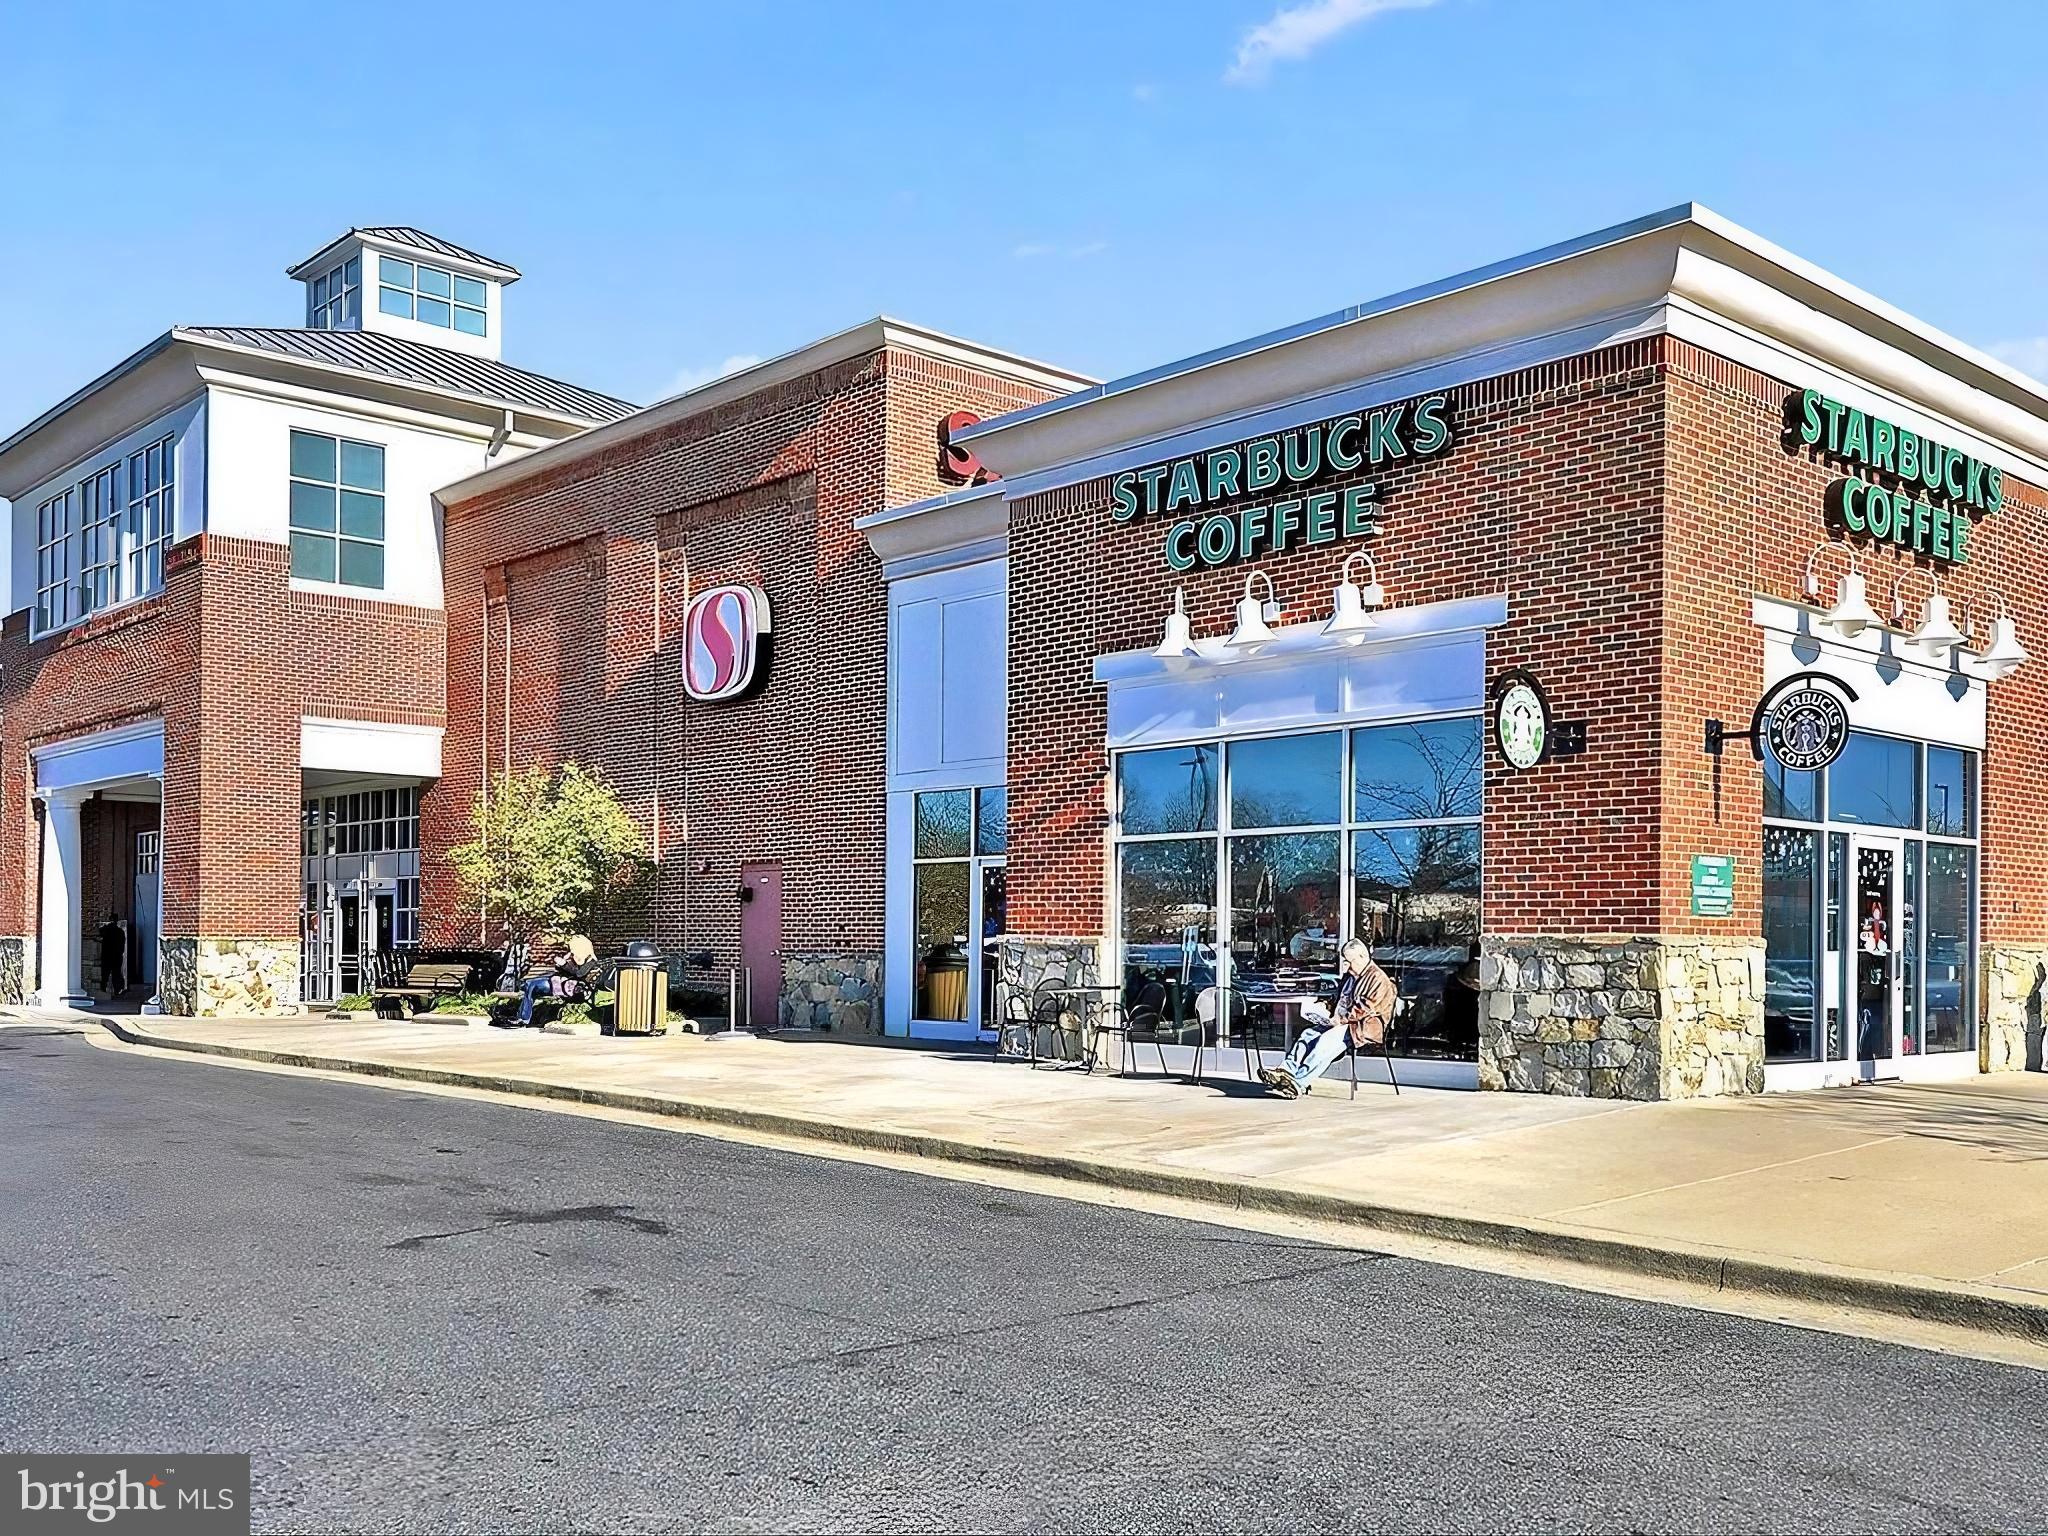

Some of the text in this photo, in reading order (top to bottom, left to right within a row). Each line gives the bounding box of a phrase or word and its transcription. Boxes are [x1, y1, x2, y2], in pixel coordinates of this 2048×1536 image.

[1112, 396, 1448, 522] STARBUCKS
[1801, 388, 2003, 514] STARBUCKS
[1165, 483, 1375, 571] COFFEE
[1842, 477, 1969, 564] COFFEE
[1771, 692, 1842, 731] STARBUCKS
[1778, 744, 1833, 767] COFFEE
